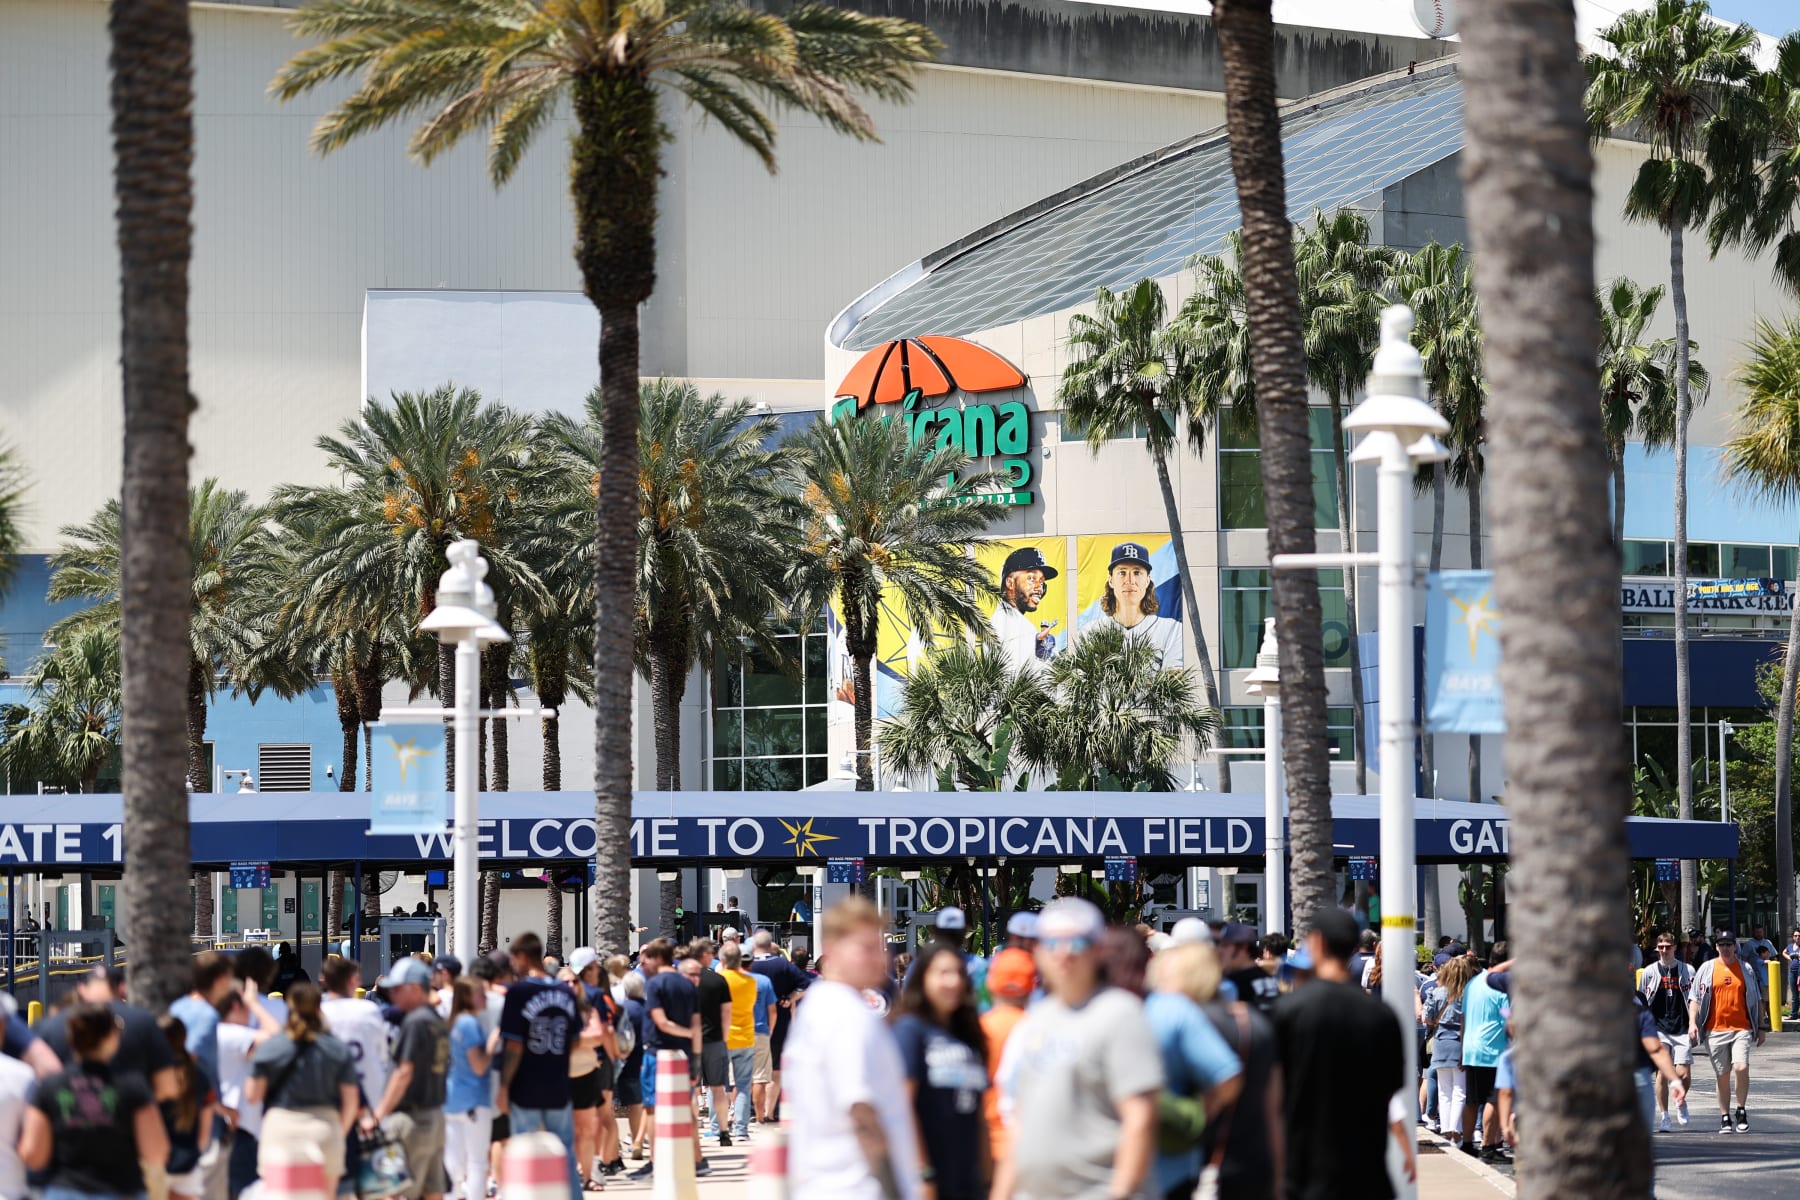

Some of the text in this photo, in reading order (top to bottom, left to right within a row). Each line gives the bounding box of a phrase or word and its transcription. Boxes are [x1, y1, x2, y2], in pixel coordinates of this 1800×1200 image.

[697, 818, 765, 856] TO
[858, 817, 1253, 855] TROPICANA FIELD
[104, 887, 110, 895] 7
